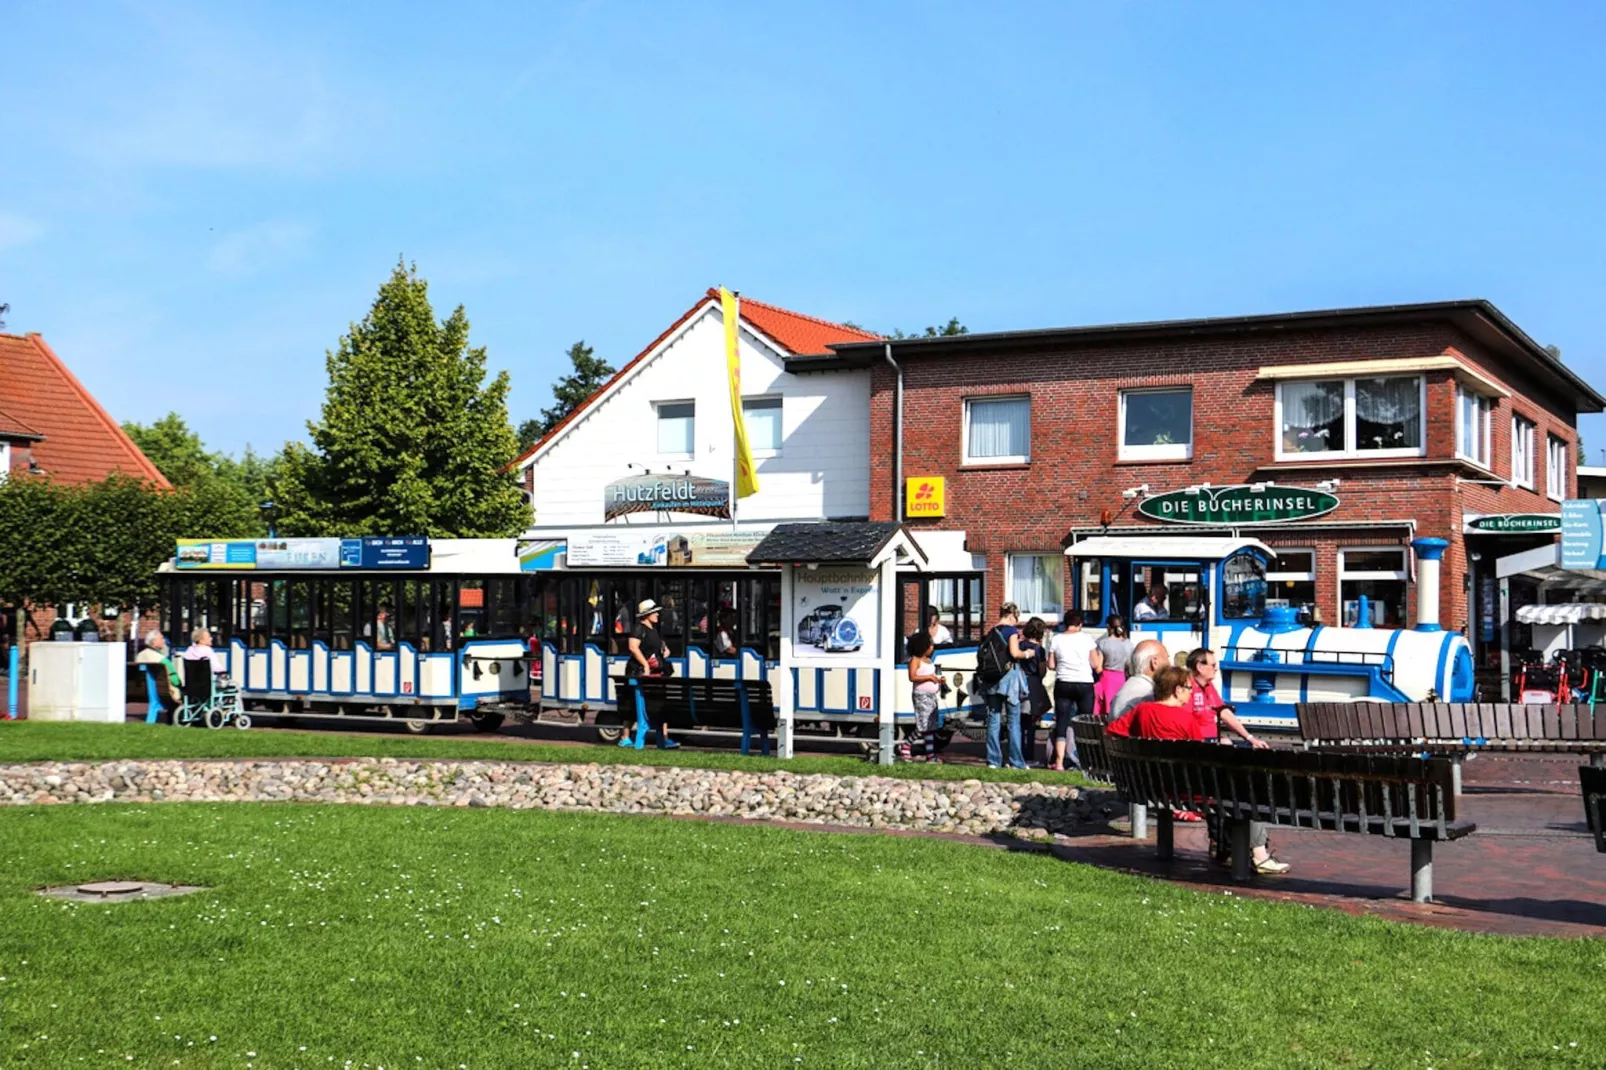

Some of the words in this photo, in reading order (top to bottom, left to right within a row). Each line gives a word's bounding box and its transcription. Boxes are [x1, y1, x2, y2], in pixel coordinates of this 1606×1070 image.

[613, 481, 697, 501] Hutzfeldt
[910, 502, 939, 511] LOTTO
[1163, 501, 1189, 513] DIE
